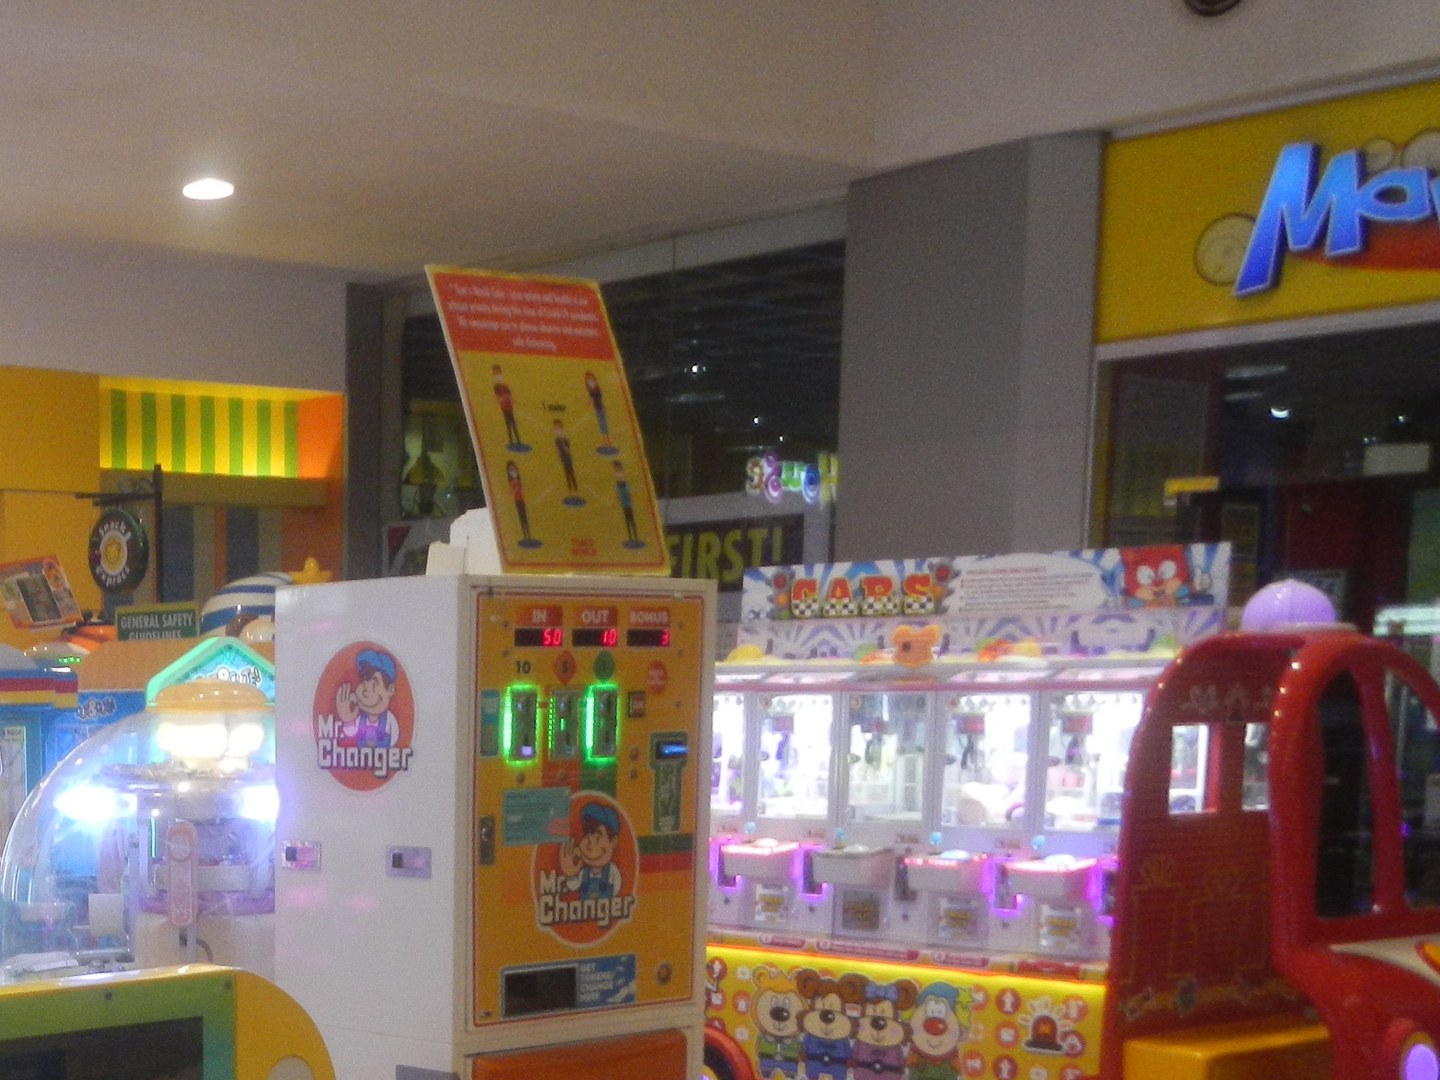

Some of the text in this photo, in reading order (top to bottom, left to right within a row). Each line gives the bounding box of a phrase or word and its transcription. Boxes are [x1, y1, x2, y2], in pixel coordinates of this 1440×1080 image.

[1233, 141, 1440, 297] Ma
[791, 573, 937, 618] CARS
[120, 612, 193, 629] GENERAL SAFETY
[532, 609, 547, 623] IN
[582, 608, 609, 624] OUT
[629, 611, 669, 624] BONUS
[543, 628, 562, 645] 50
[515, 660, 532, 674] 10
[318, 713, 345, 739] Mr.
[317, 739, 413, 778] Changer
[539, 869, 569, 896] Mr.
[539, 894, 636, 929] Changer
